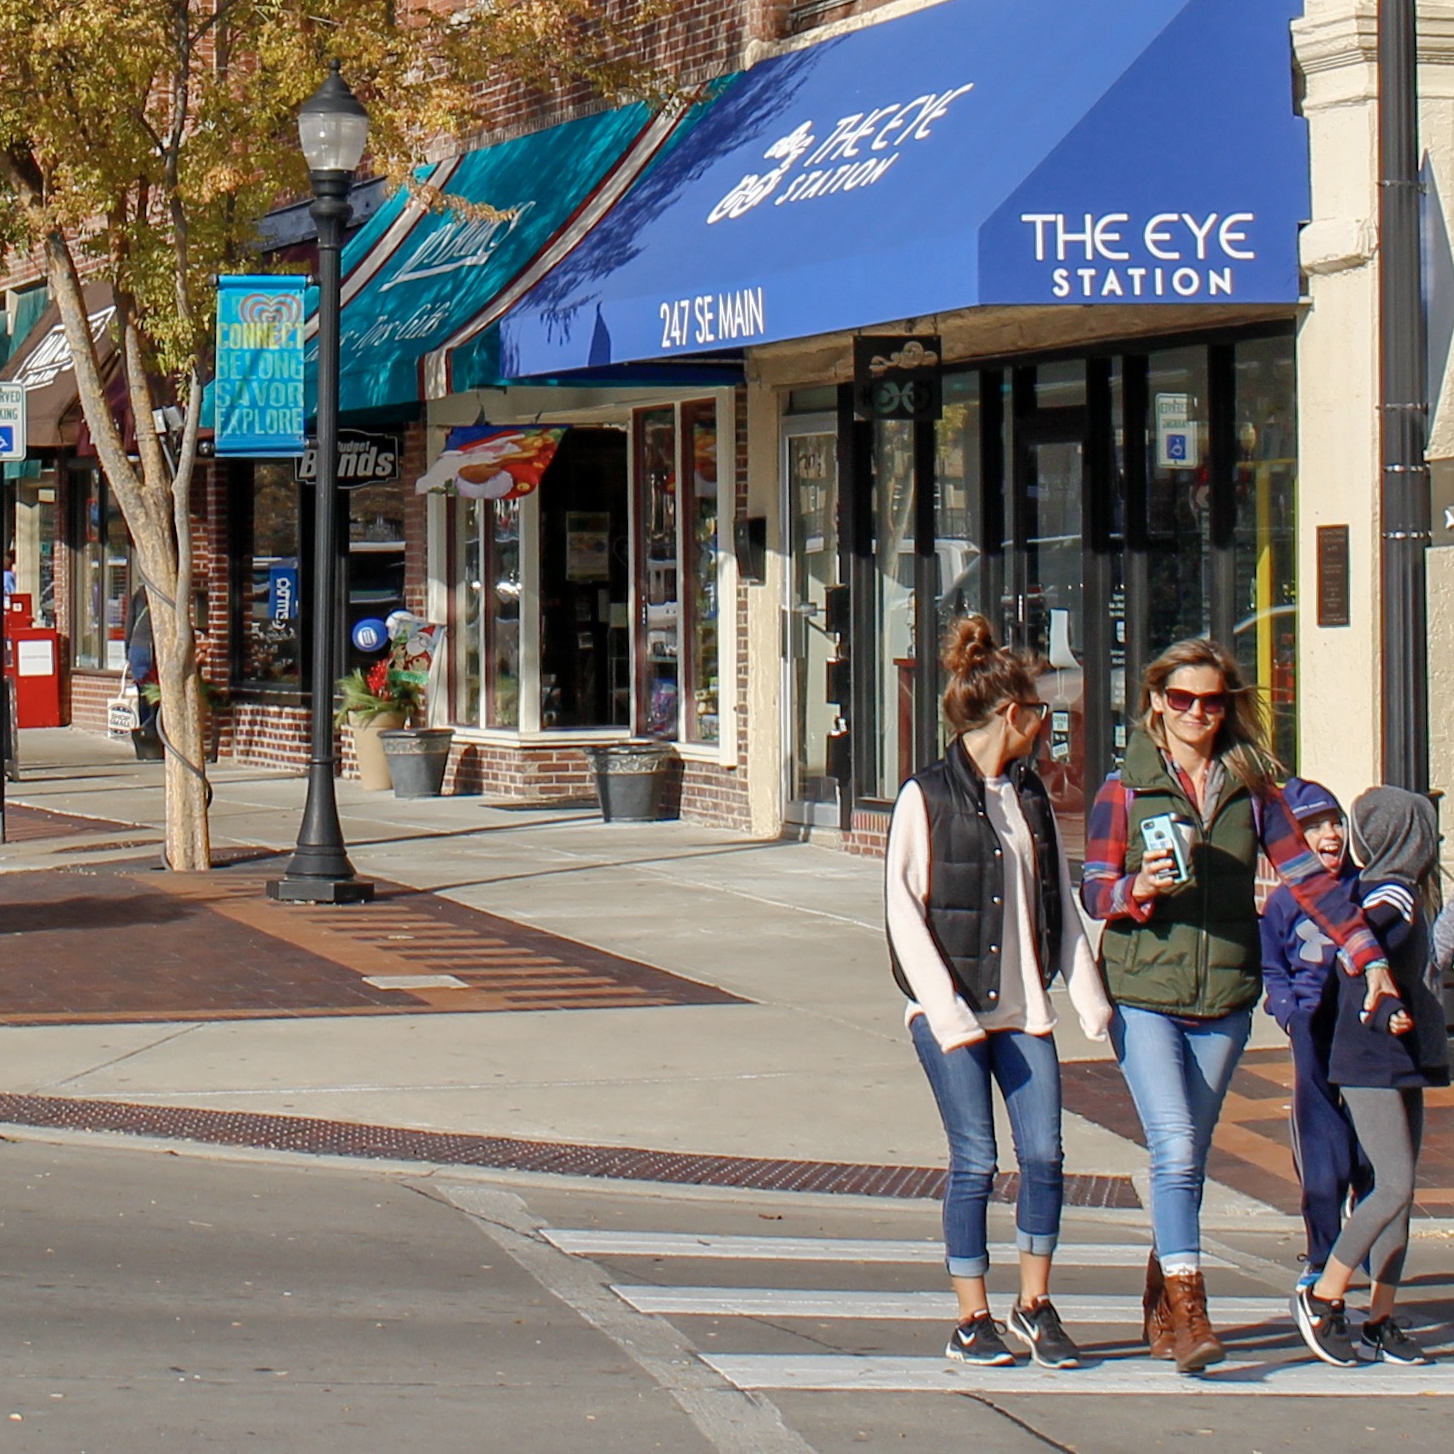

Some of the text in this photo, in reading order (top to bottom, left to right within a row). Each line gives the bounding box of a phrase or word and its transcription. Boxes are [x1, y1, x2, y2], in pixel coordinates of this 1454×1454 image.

[803, 82, 974, 167] THE EYE
[774, 151, 899, 206] STATION
[1020, 212, 1255, 262] THE EYE
[1052, 267, 1232, 298] STATION
[659, 286, 765, 348] 247 SE MAIN
[216, 321, 304, 350] CONNECT
[217, 350, 304, 380] BELONG
[216, 381, 304, 408] SAVOR
[216, 407, 304, 435] EXPLORE
[299, 446, 395, 478] Bnds
[337, 440, 370, 453] udget
